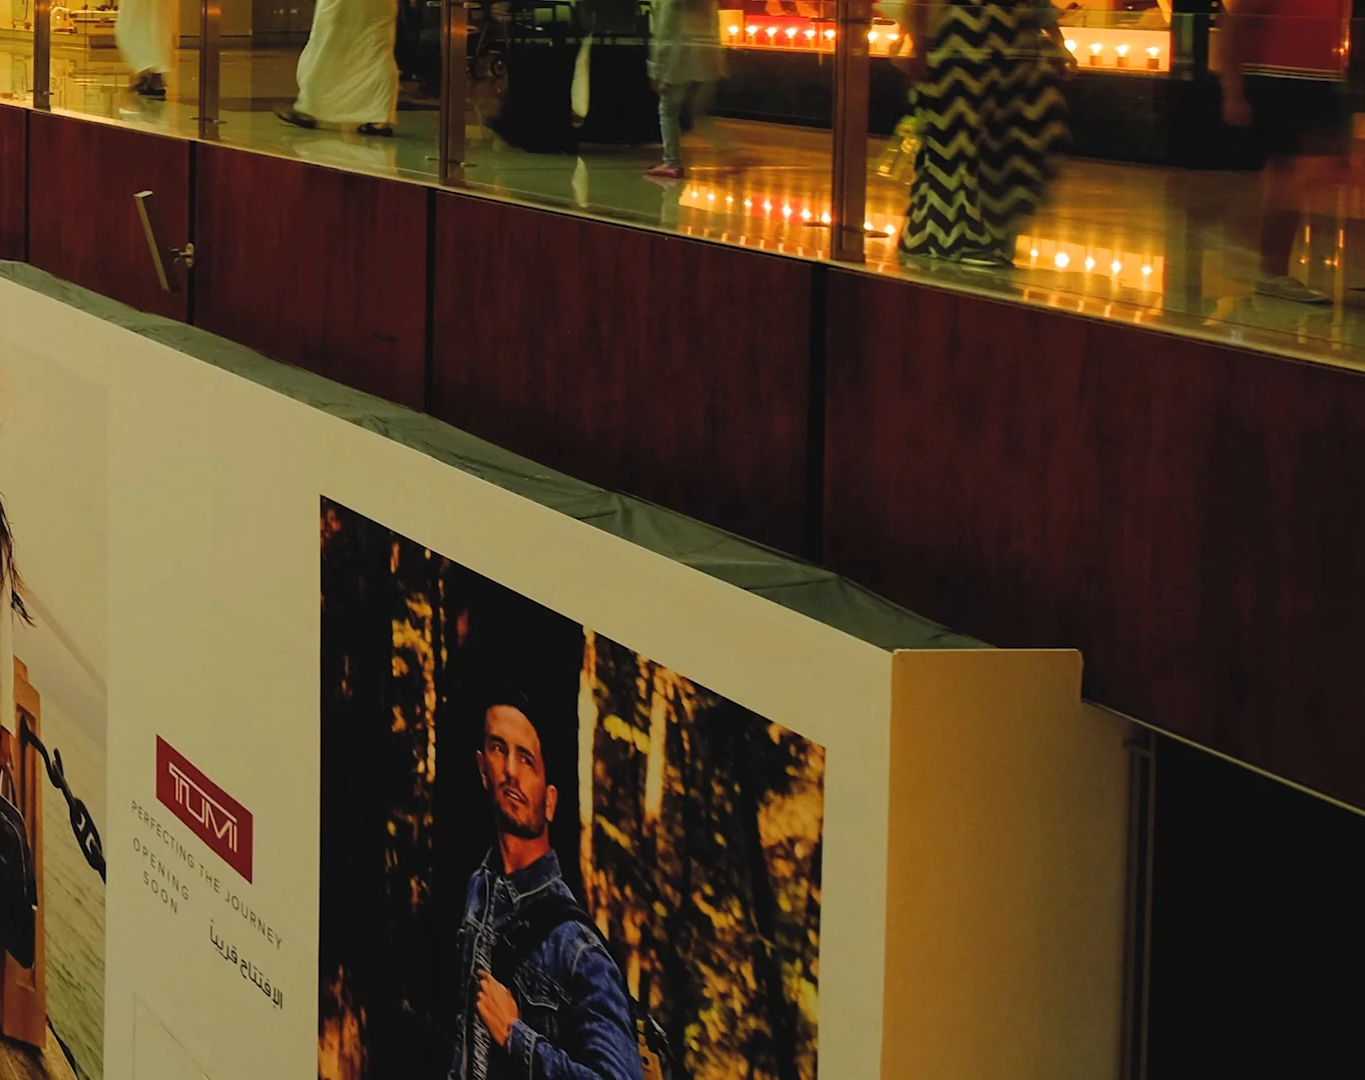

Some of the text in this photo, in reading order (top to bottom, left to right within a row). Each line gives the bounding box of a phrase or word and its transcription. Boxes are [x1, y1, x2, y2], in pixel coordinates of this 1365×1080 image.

[168, 762, 238, 854] TUMI
[131, 800, 283, 951] PERFECTING THE JOURNEY
[132, 837, 190, 901] OPENING
[142, 870, 178, 915] SOON
